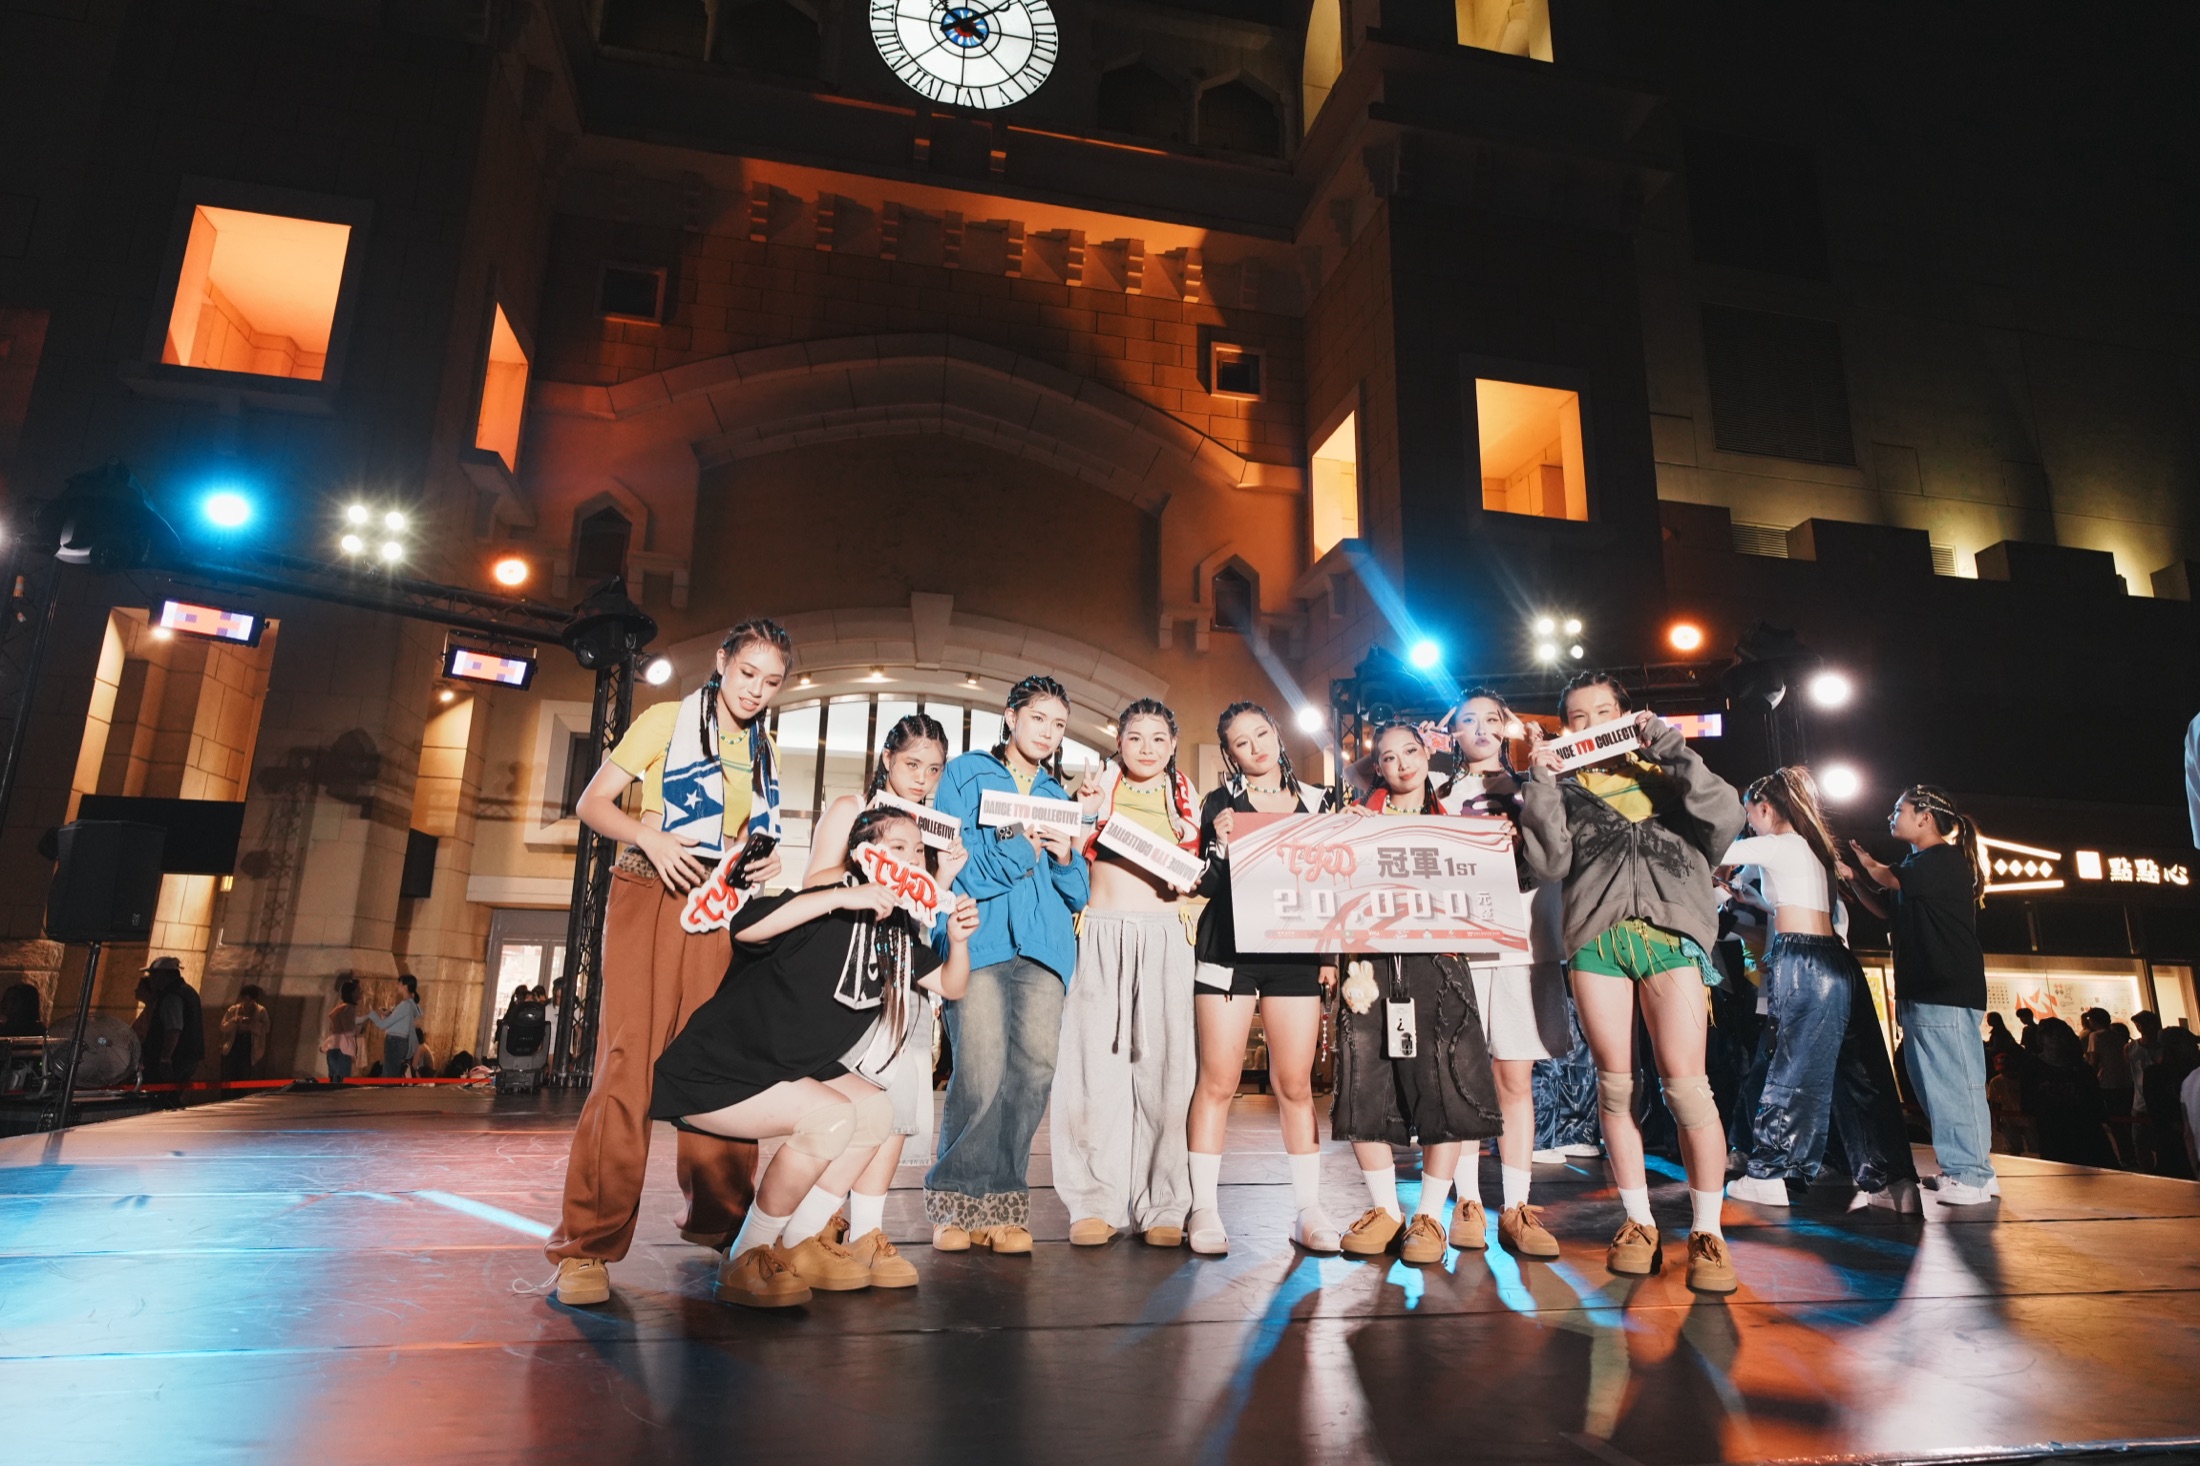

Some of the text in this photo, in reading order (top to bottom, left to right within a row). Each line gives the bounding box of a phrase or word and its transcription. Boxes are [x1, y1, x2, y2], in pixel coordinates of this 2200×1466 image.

[1574, 738, 1596, 756] TYD
[982, 799, 1080, 826] DANCE TYD COLLECTIVE
[1105, 821, 1197, 882] DANCE TYD COLLECTIVE
[1377, 846, 1442, 879] 冠軍
[1444, 857, 1478, 877] 1ST
[2108, 856, 2190, 886] 點點心
[1273, 888, 1471, 925] 20,000
